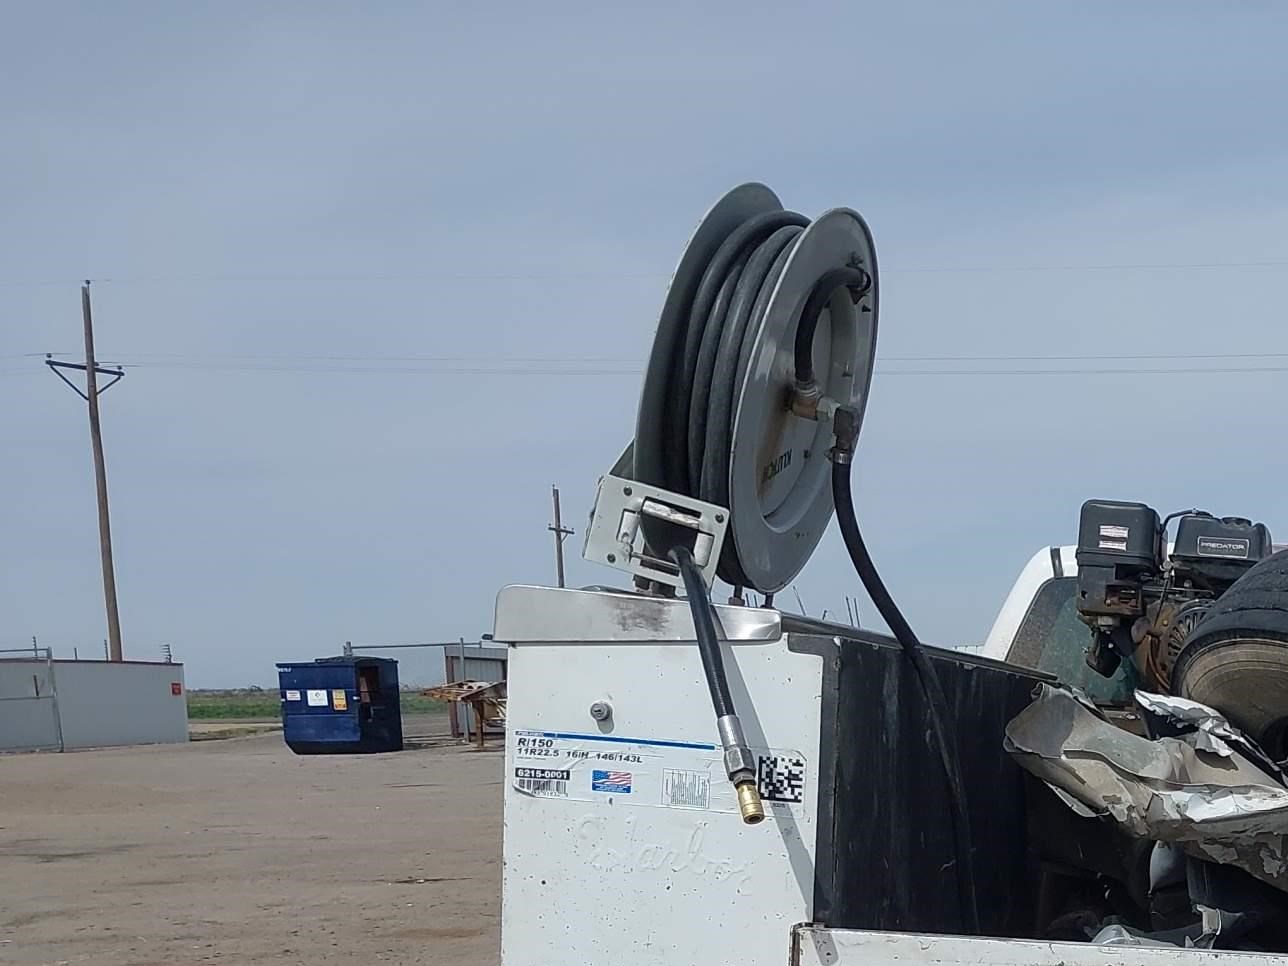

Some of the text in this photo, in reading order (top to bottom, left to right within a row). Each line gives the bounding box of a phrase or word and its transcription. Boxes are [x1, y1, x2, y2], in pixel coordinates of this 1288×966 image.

[1200, 541, 1246, 551] PREDATOR
[517, 747, 560, 757] 11R22.5
[595, 752, 643, 764] 146/143L
[516, 769, 568, 780] 6215-0001
